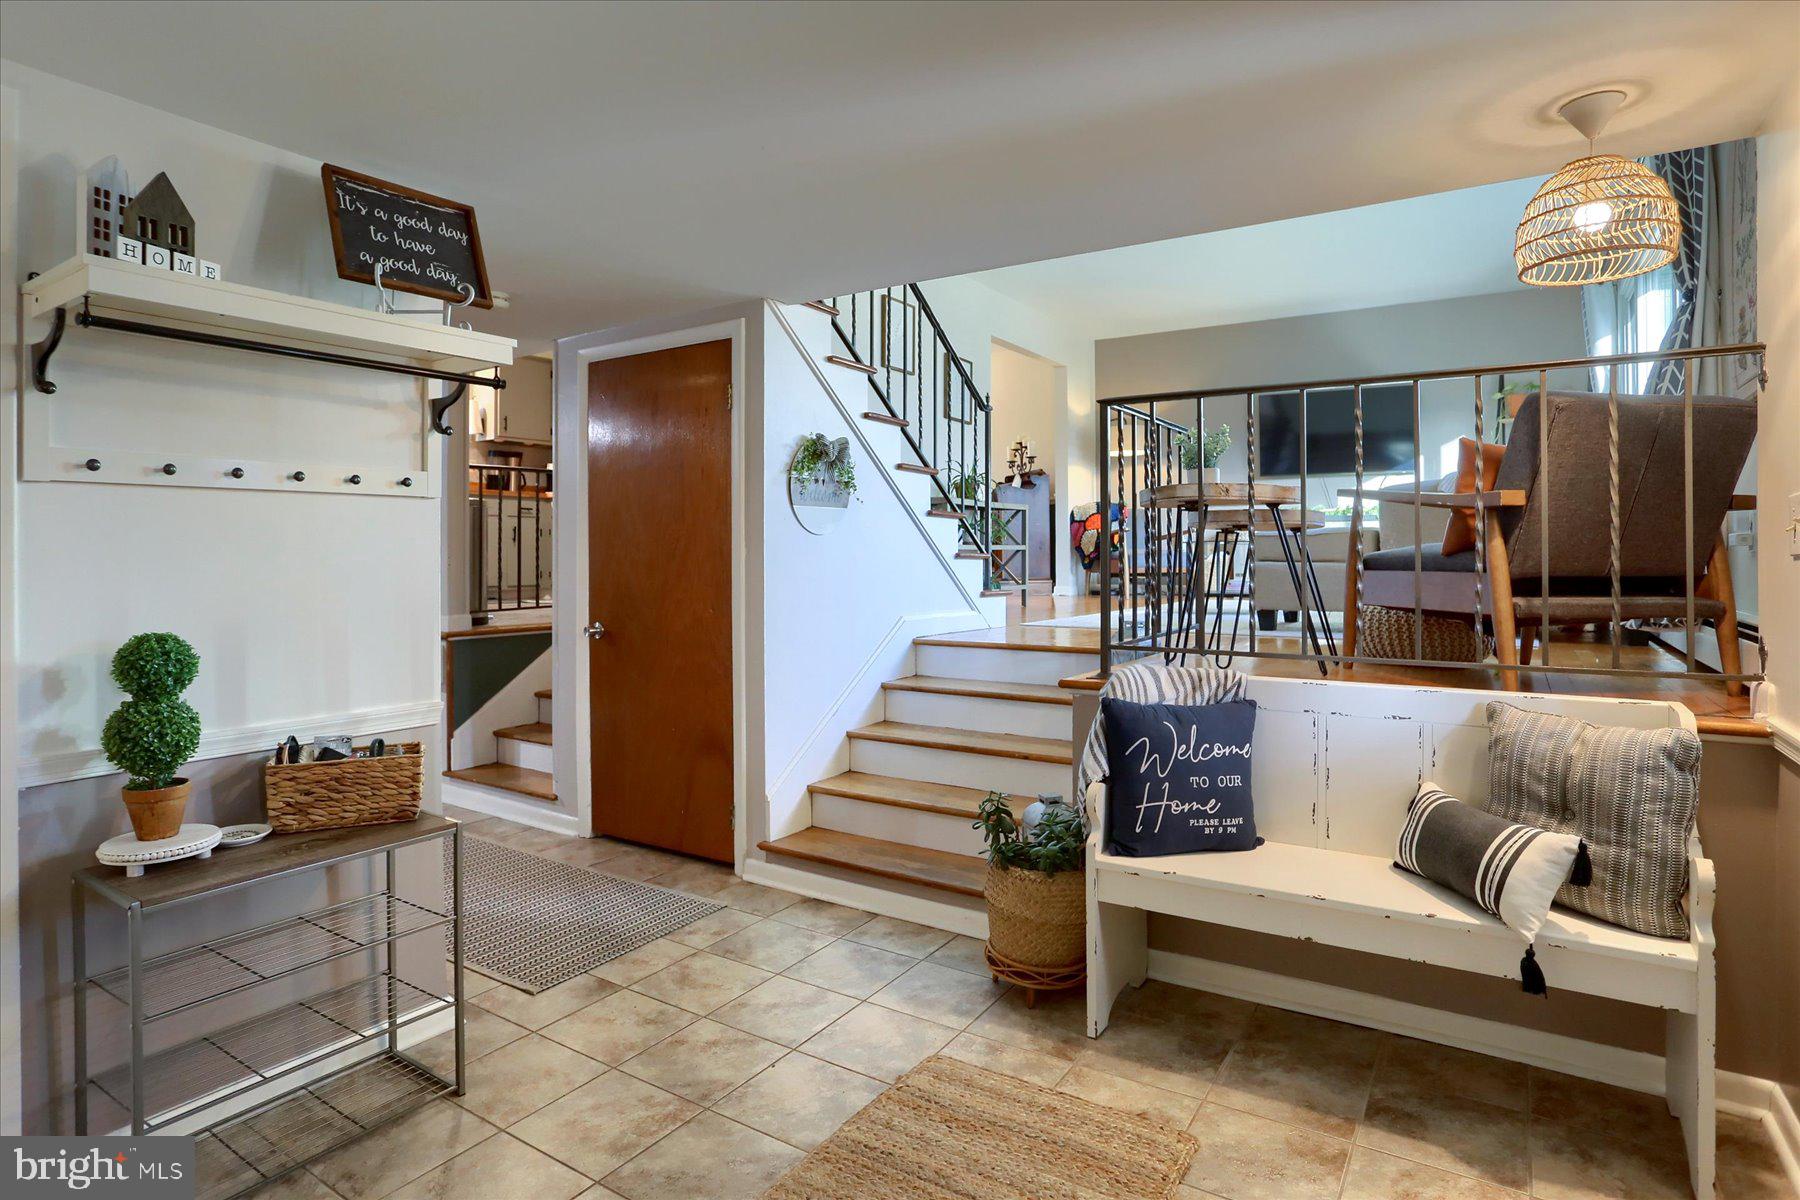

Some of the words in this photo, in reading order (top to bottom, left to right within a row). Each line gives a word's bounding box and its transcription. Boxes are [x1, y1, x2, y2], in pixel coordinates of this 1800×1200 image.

[336, 187, 368, 215] It's
[374, 208, 388, 221] a
[394, 213, 433, 233] good
[438, 222, 469, 246] day
[369, 225, 389, 242] to
[394, 231, 436, 255] have
[360, 251, 374, 264] a
[380, 256, 421, 276] good
[426, 263, 461, 286] day.
[1125, 721, 1252, 778] Welcome
[1190, 776, 1210, 788] TO
[1217, 775, 1242, 787] OUR
[1135, 782, 1221, 833] Home
[1189, 818, 1219, 826] PLEASE
[1222, 817, 1244, 826] LEAVE
